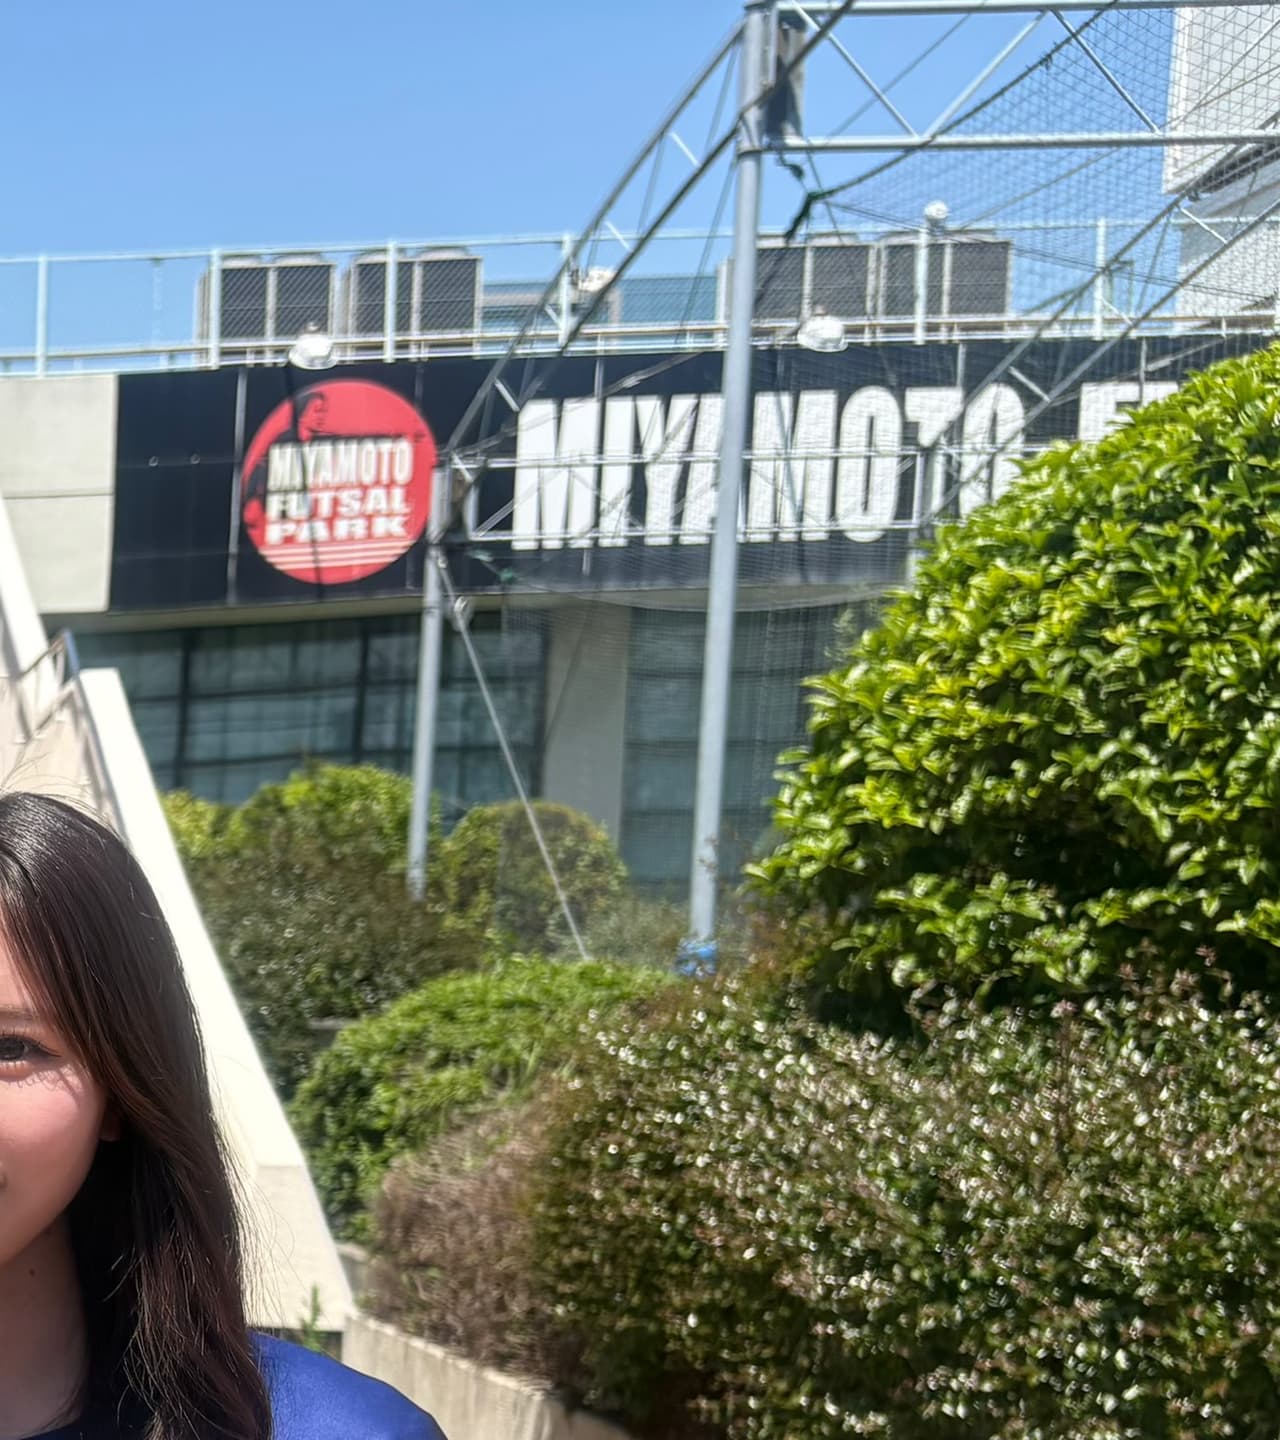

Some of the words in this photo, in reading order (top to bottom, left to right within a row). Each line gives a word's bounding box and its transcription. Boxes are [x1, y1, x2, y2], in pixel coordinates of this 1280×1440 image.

[268, 437, 414, 490] MIYAMOTO
[511, 384, 1025, 550] MIYAMOTO
[265, 486, 411, 520] FUTSAL
[265, 515, 411, 545] PARK
